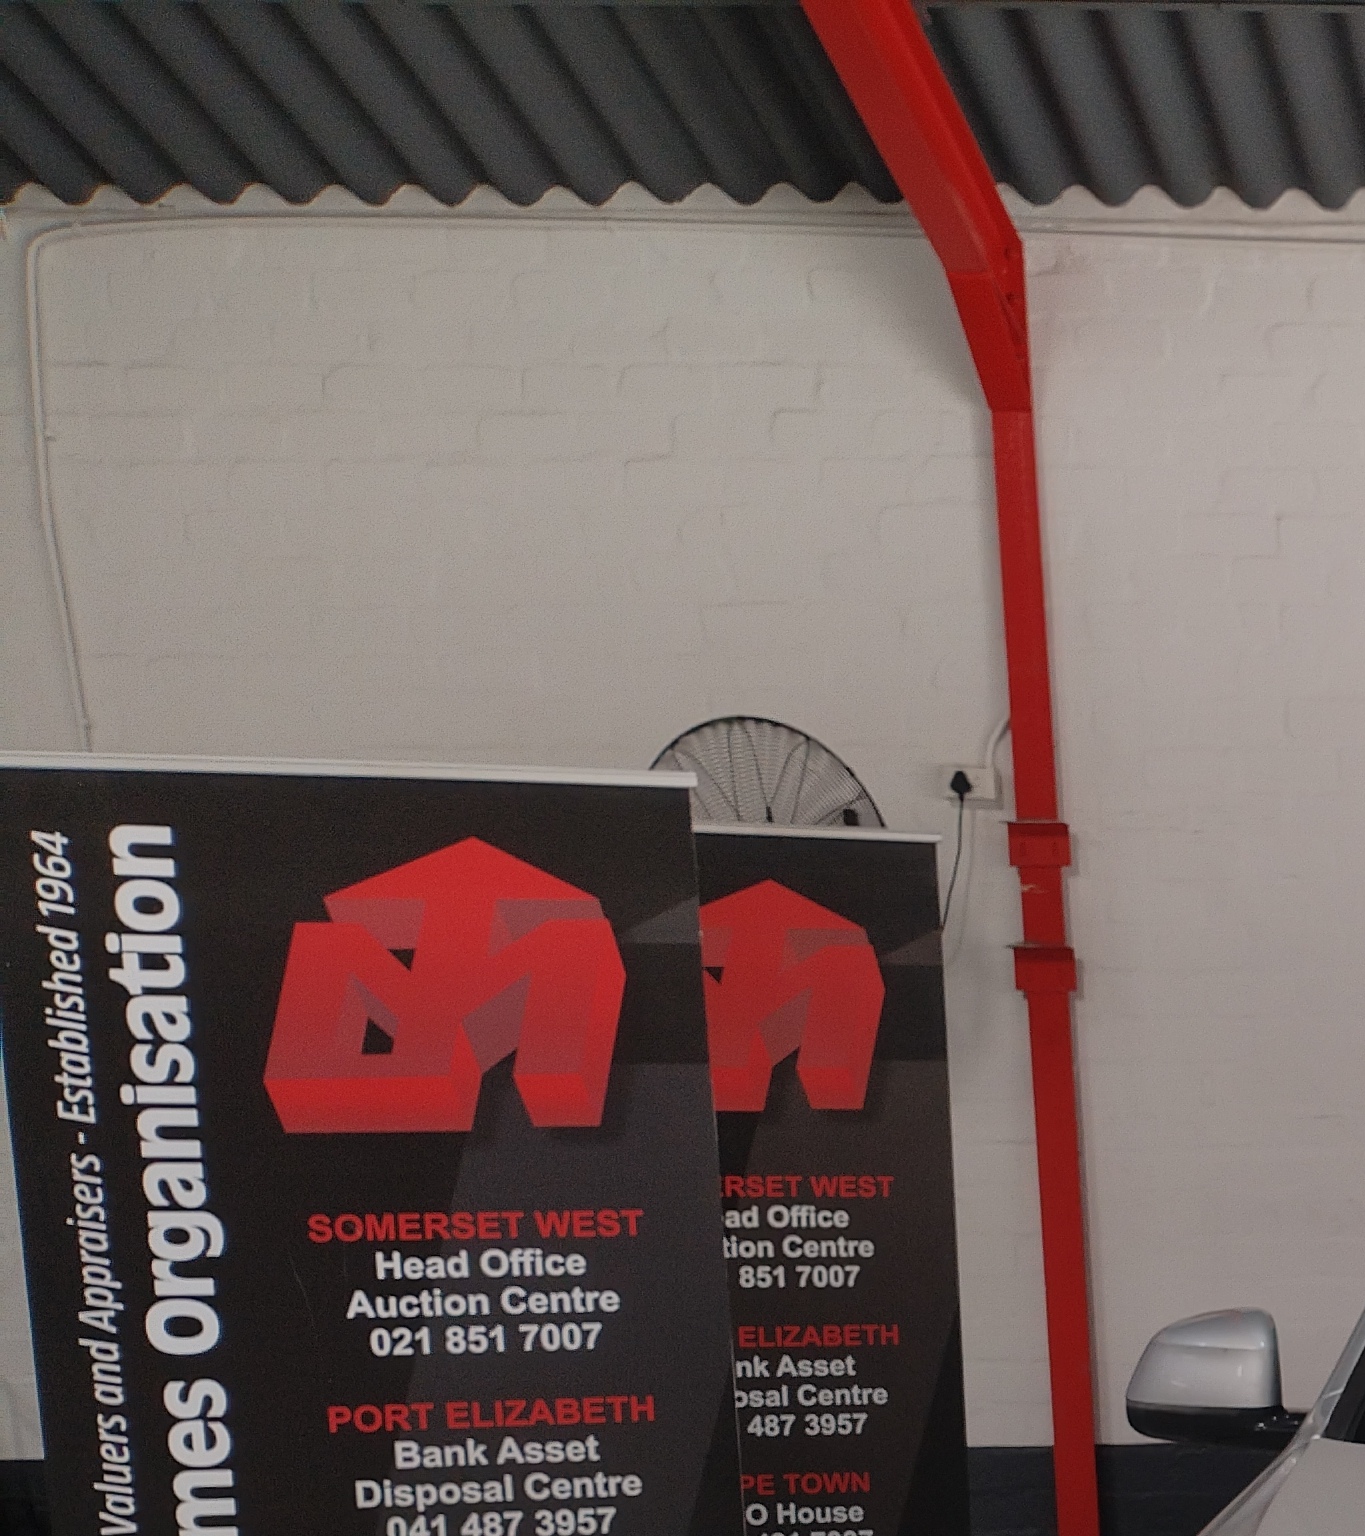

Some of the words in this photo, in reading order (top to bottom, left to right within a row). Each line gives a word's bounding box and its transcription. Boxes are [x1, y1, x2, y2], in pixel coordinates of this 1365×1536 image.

[30, 830, 76, 917] 1964
[41, 924, 97, 1124] Established
[106, 824, 225, 1356] Organisation
[723, 1174, 802, 1198] RSET
[810, 1175, 894, 1198] WEST
[307, 1211, 524, 1243] SOMERSET
[533, 1208, 643, 1238] WEST
[724, 1205, 760, 1229] ad
[766, 1204, 850, 1229] Office
[65, 1152, 125, 1334] Appraisers
[722, 1234, 775, 1259] tion
[782, 1234, 875, 1259] Centre
[374, 1250, 470, 1280] Head
[479, 1247, 587, 1278] Office
[738, 1265, 786, 1289] 851
[795, 1264, 861, 1288] 7007
[346, 1286, 488, 1320] Auction
[500, 1285, 621, 1315] Centre
[369, 1326, 431, 1357] 021
[445, 1324, 506, 1355] 851
[518, 1321, 603, 1352] 7007
[737, 1323, 900, 1348] ELIZABETH
[84, 1338, 125, 1406] and
[735, 1356, 770, 1378] nk
[775, 1354, 857, 1378] Asset
[735, 1385, 788, 1408] osal
[796, 1383, 889, 1407] Centre
[326, 1402, 434, 1434] PORT
[445, 1395, 655, 1430] ELIZABETH
[746, 1413, 797, 1437] 487
[804, 1412, 869, 1436] 3957
[394, 1437, 489, 1470] Bank
[496, 1434, 601, 1466] Asset
[93, 1413, 138, 1536] Valuers
[354, 1474, 514, 1512] Disposal
[523, 1471, 643, 1501] Centre
[741, 1474, 776, 1496] PE
[783, 1471, 871, 1495] TOWN
[776, 1501, 865, 1525] House
